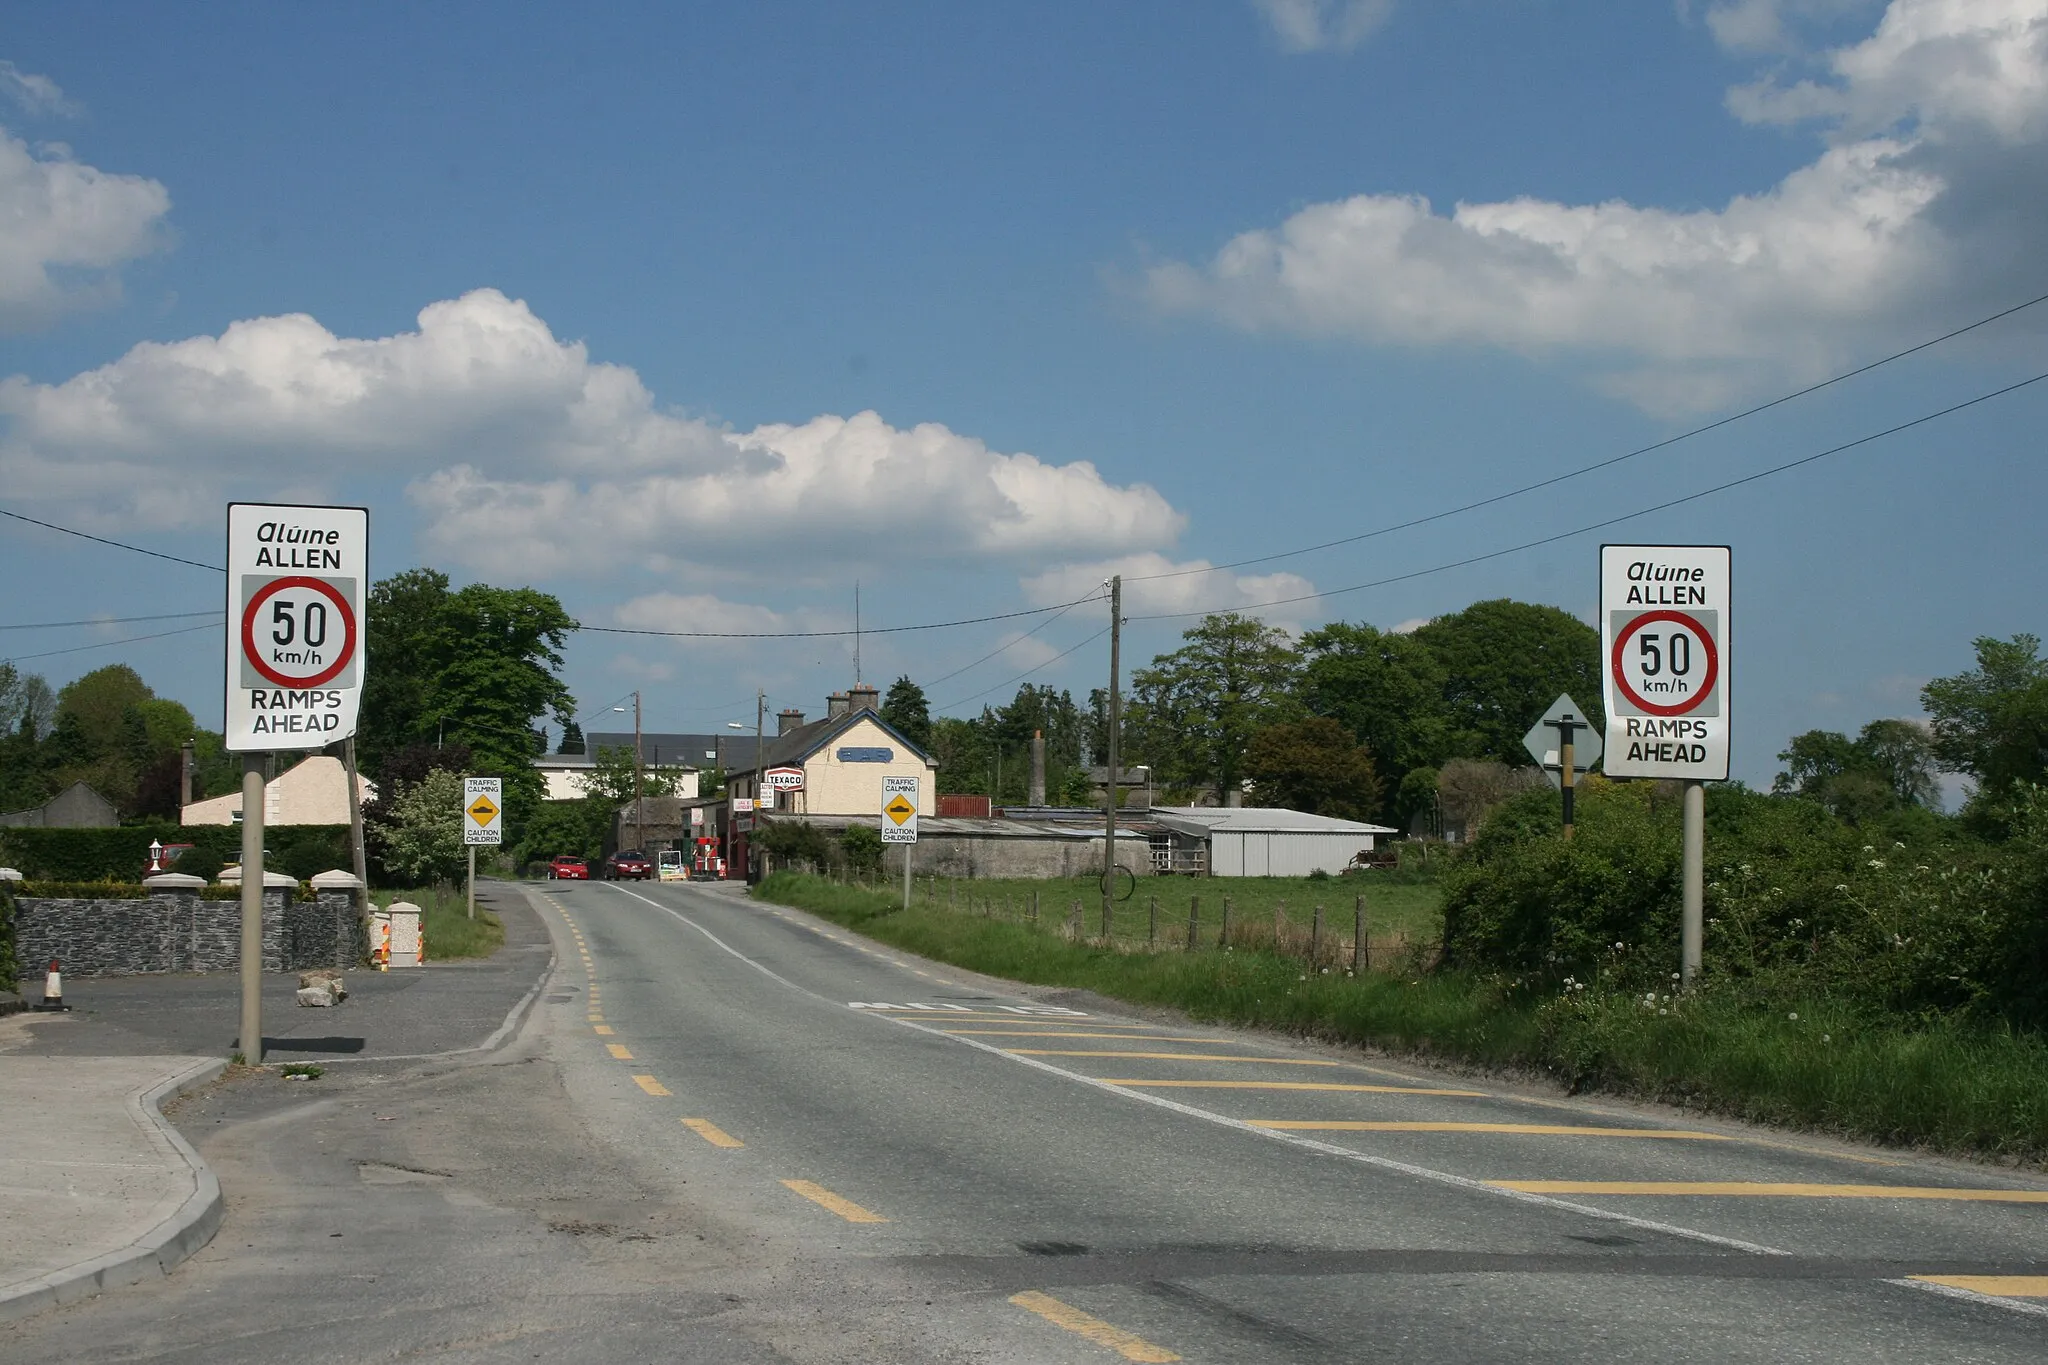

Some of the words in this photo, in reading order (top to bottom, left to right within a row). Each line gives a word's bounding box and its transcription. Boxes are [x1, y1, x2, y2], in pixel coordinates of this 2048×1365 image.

[255, 547, 341, 569] ALLEN
[1626, 585, 1705, 605] ALLEN
[272, 600, 327, 648] 50
[273, 649, 322, 665] km/h
[1639, 633, 1690, 676] 50
[1643, 678, 1688, 693] km/h
[251, 689, 342, 710] RAMPS
[252, 713, 340, 734] AHEAD
[1626, 718, 1708, 739] RAMPS
[1626, 742, 1706, 763] AHEAD
[769, 776, 801, 784] TEXACO
